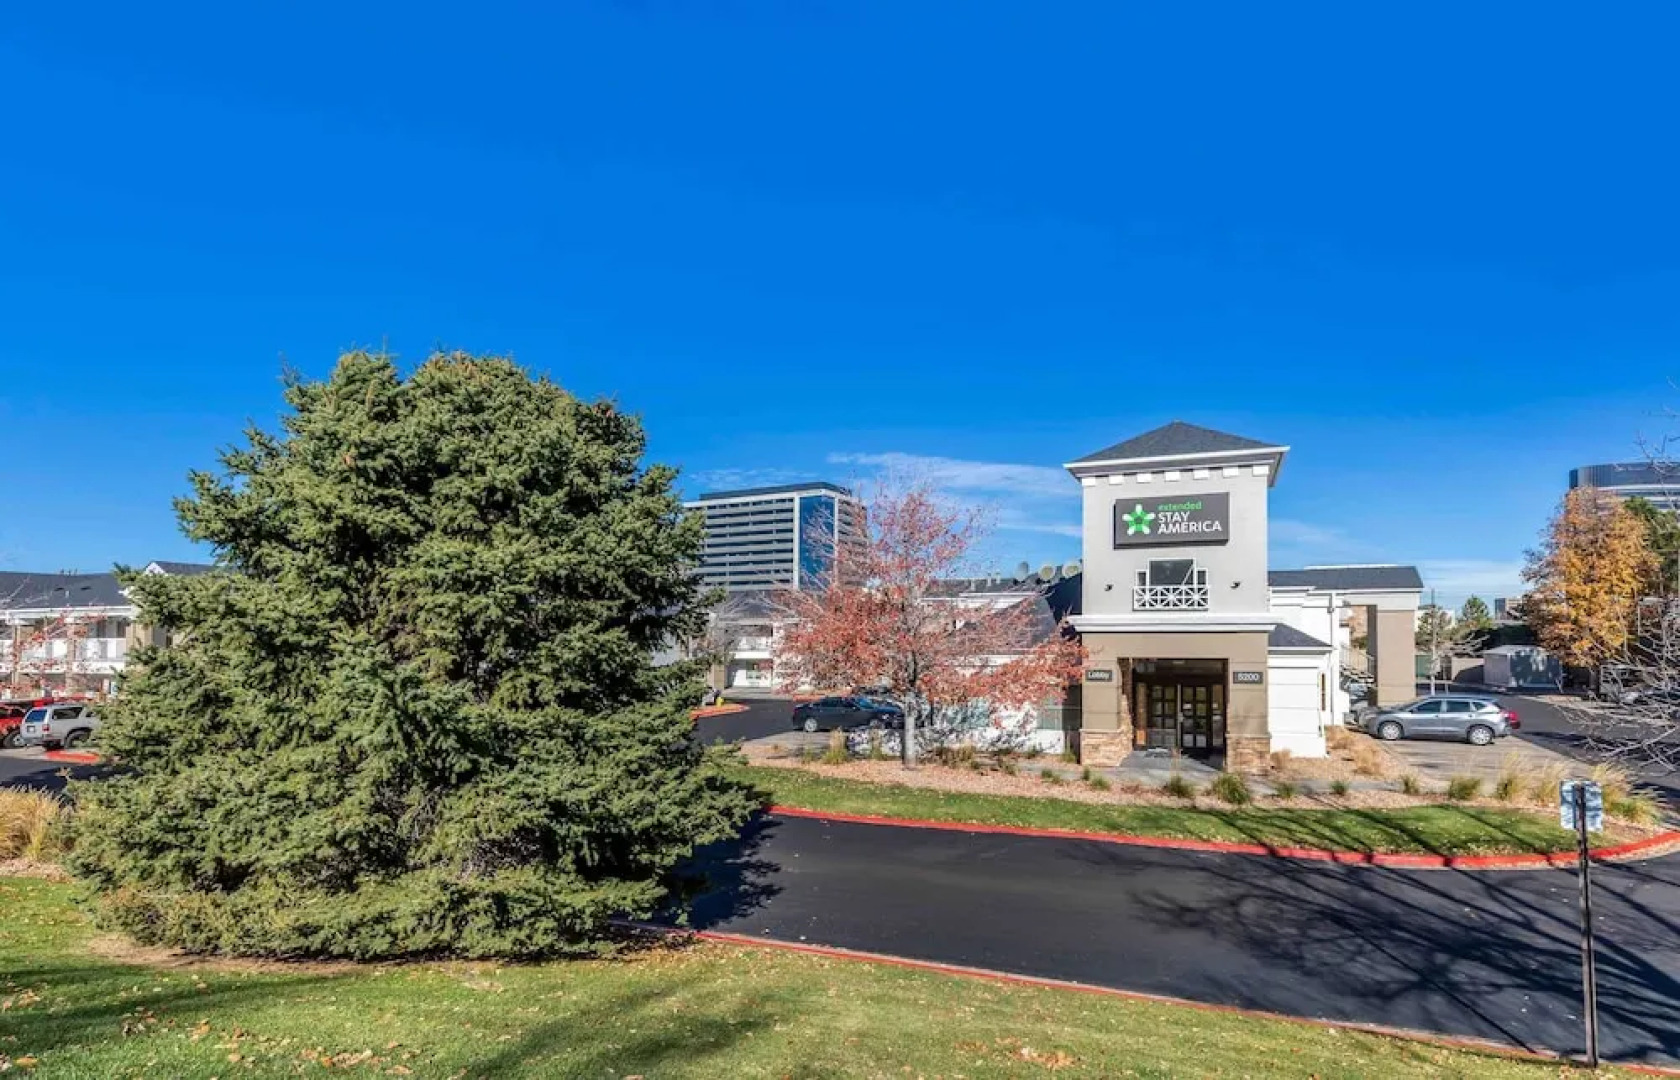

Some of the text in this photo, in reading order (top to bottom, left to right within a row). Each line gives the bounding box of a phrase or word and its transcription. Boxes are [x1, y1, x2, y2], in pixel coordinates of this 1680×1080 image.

[1158, 502, 1202, 511] extended
[1158, 511, 1190, 523] STAY
[1157, 520, 1222, 534] AMERICA
